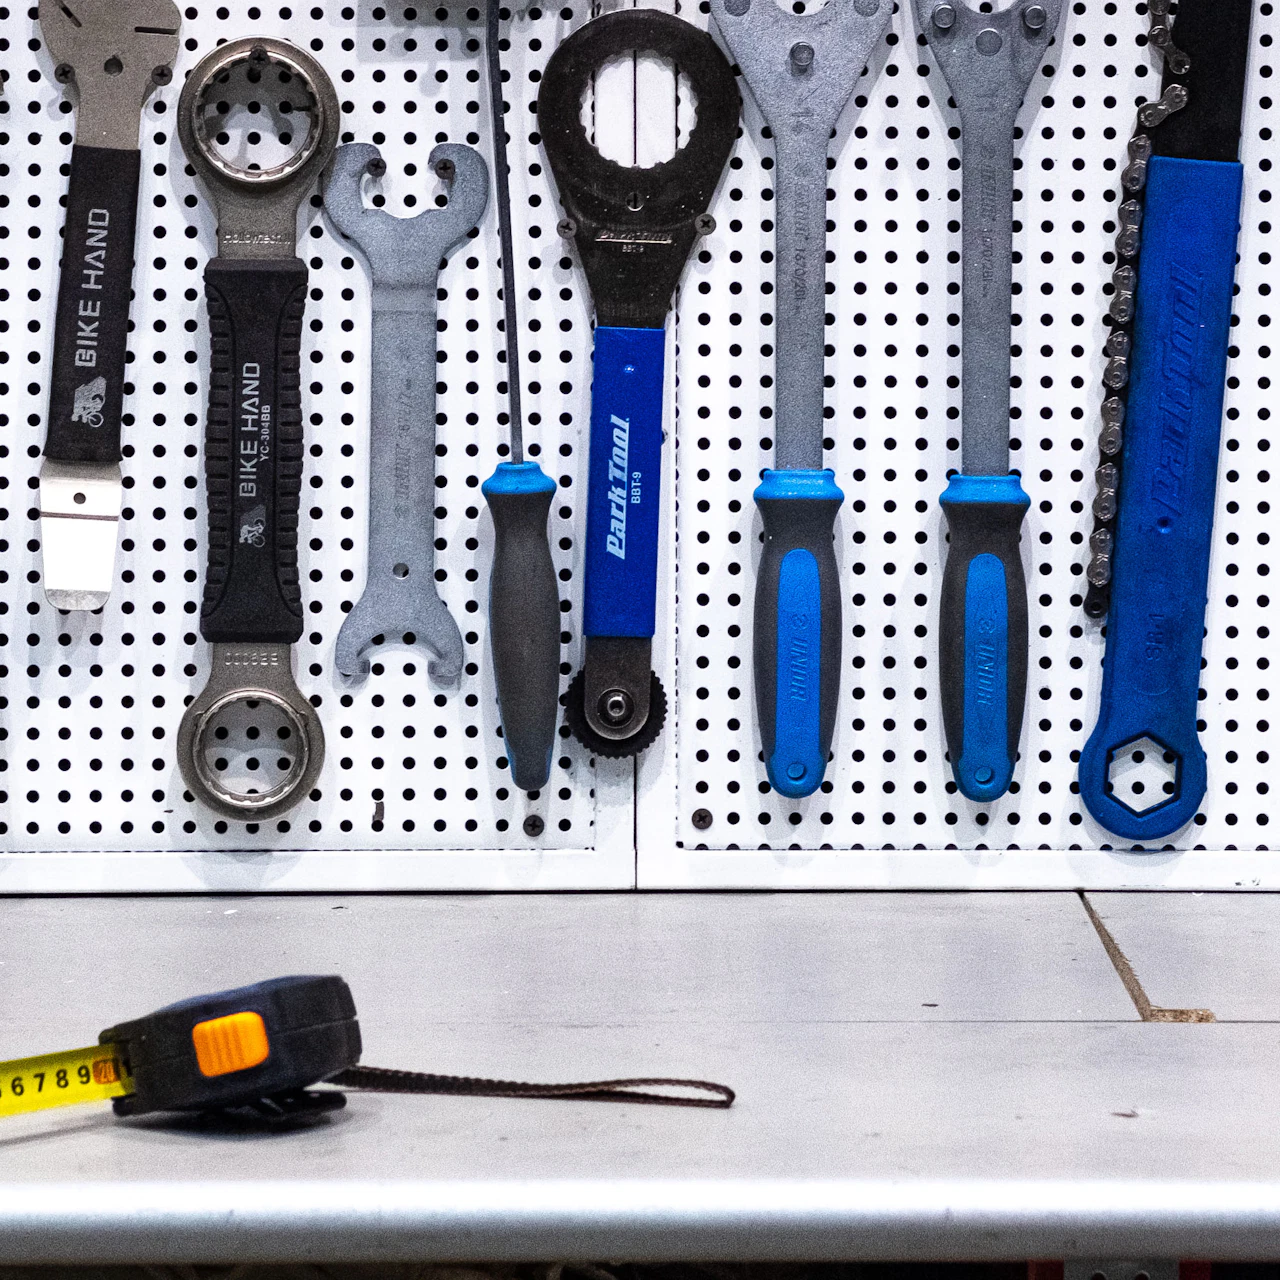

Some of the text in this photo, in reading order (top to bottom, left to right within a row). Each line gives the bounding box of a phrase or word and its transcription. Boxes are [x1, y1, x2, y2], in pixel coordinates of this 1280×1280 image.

[74, 208, 110, 368] BIKE HAND
[239, 362, 261, 497] BIKE HAND
[260, 404, 271, 462] YC-304BB
[606, 414, 630, 560] Park Tool
[631, 471, 642, 504] BBT-9
[11, 1076, 25, 1097] 6
[33, 1073, 46, 1093] 7
[55, 1069, 69, 1089] 8
[77, 1065, 91, 1085] 9
